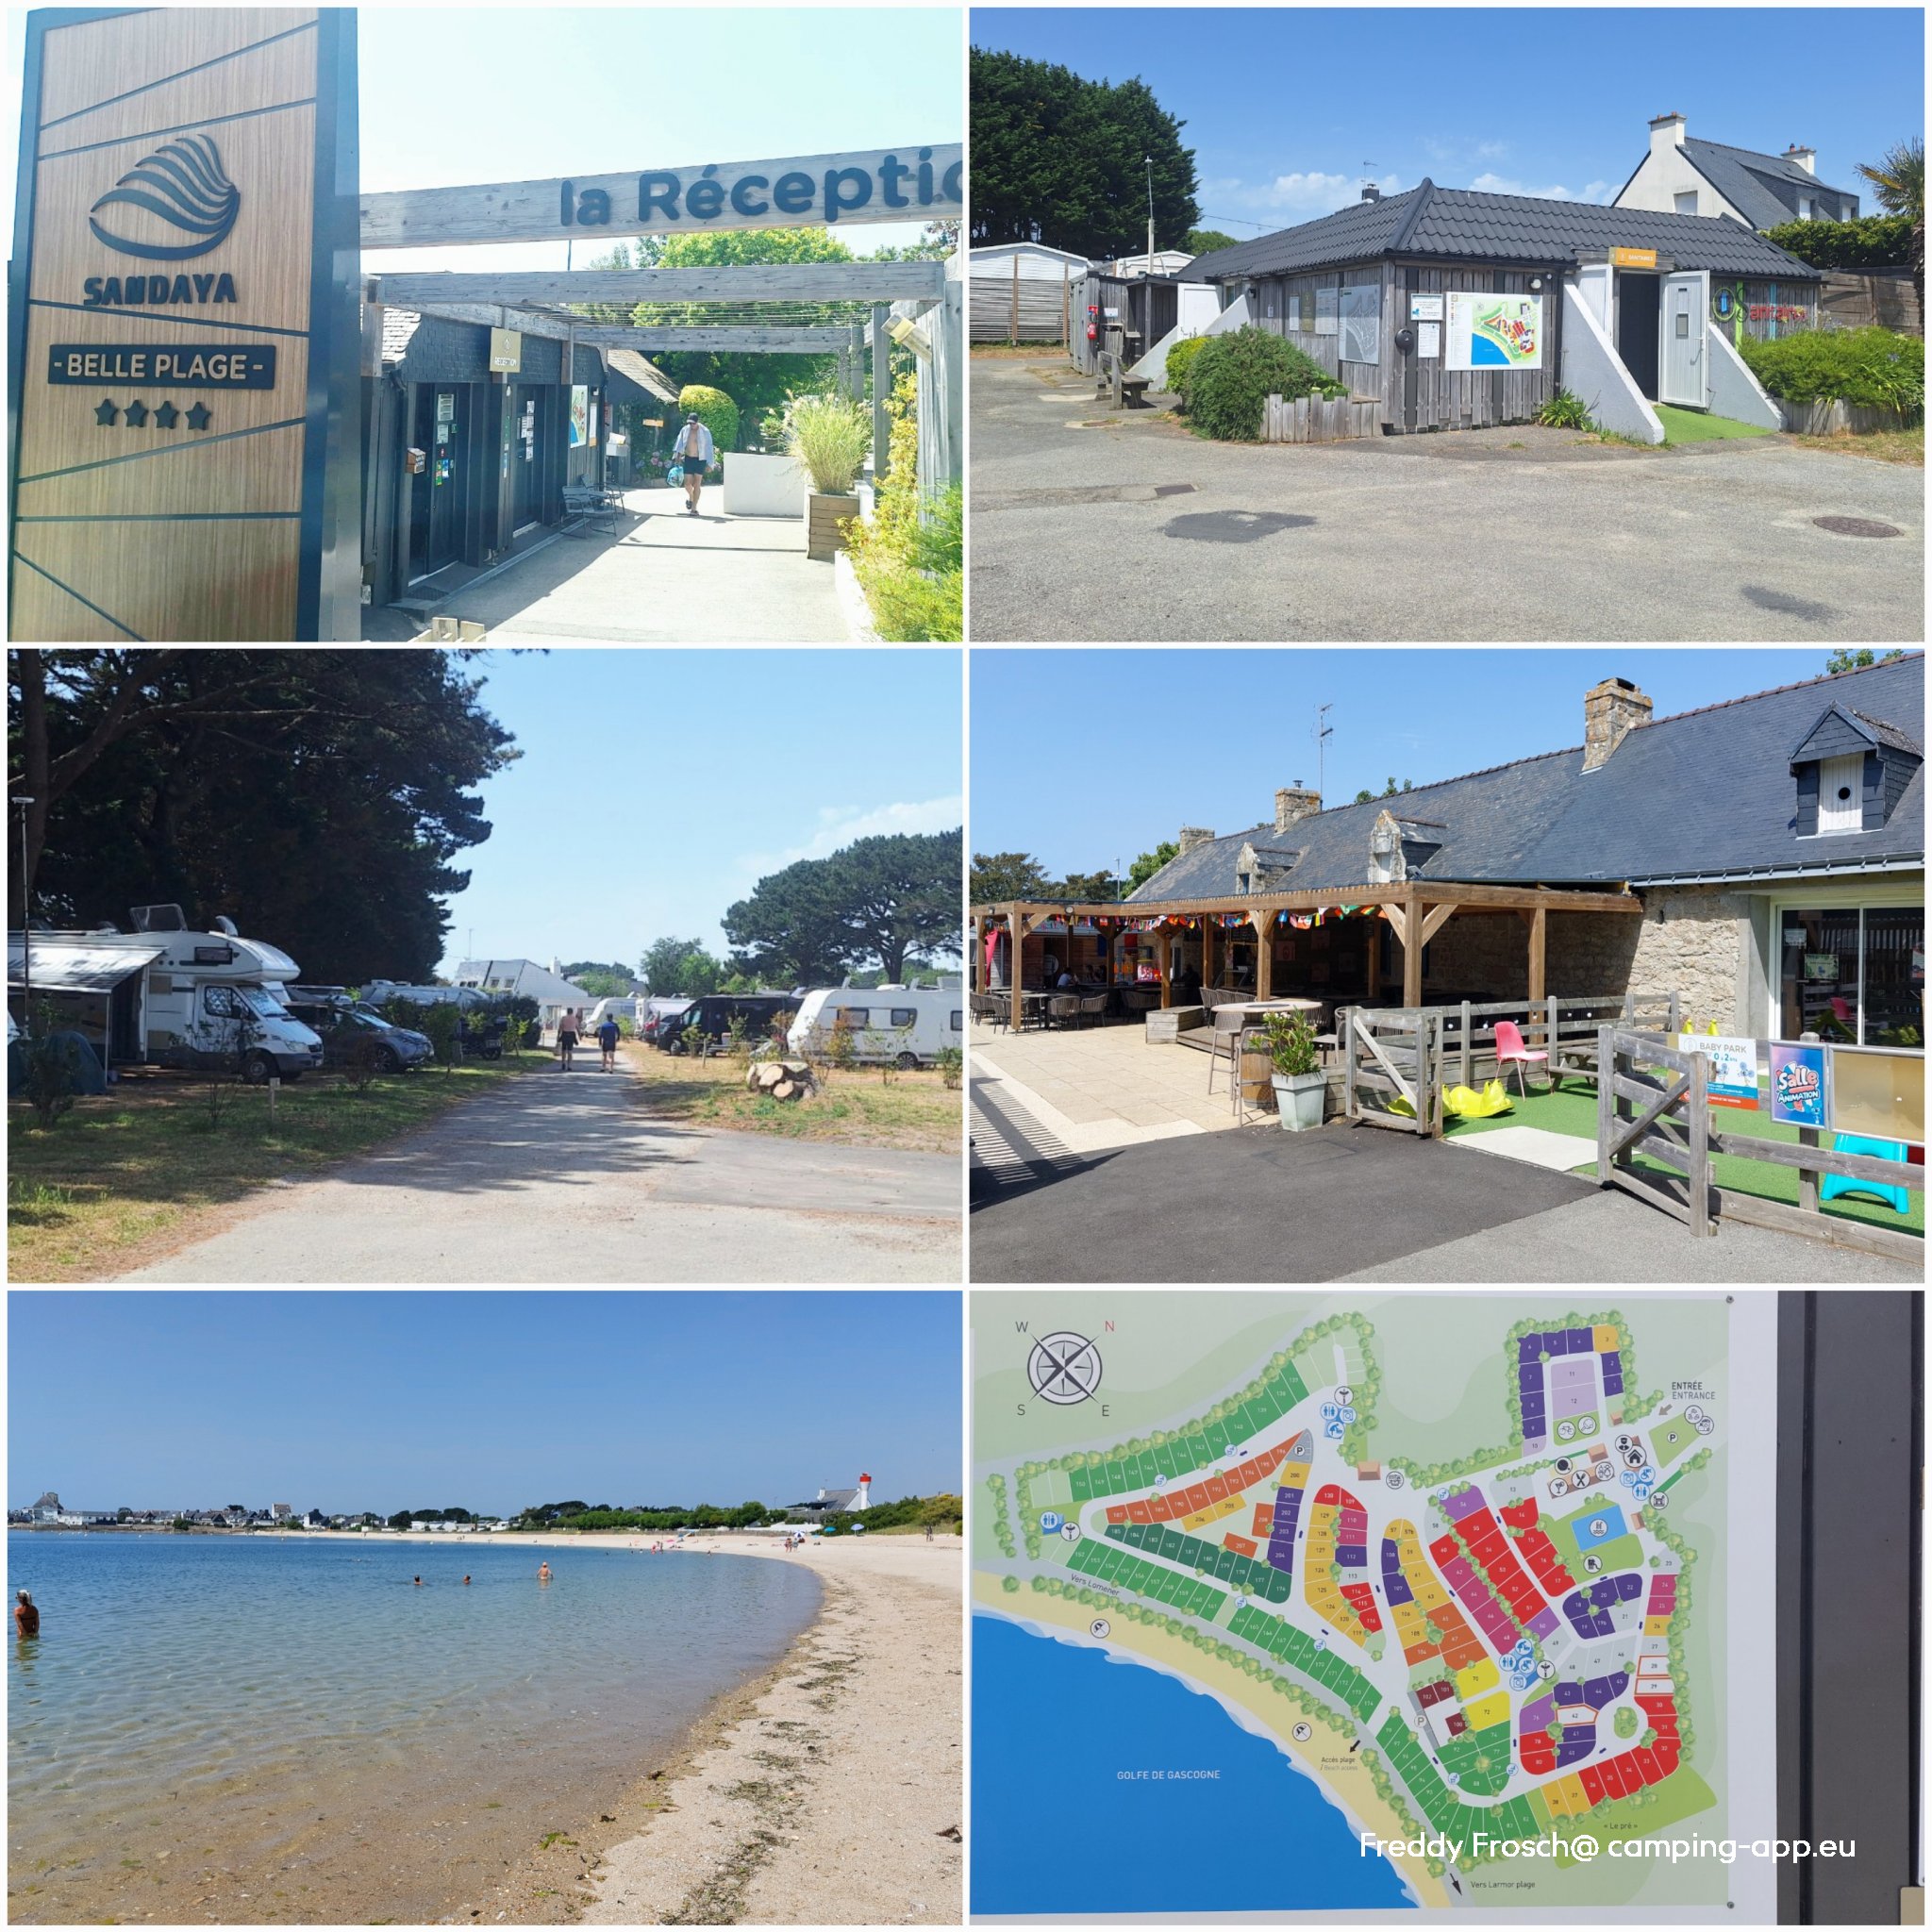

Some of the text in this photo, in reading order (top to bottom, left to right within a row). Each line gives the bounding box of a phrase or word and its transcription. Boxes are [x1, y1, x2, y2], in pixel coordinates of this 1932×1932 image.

[560, 179, 611, 226] la
[83, 273, 238, 306] SANDAYA
[1699, 1042, 1747, 1053] BABY PARK
[1714, 1052, 1719, 1060] 0
[1724, 1053, 1729, 1061] 2
[1778, 1068, 1818, 1090] Salle
[1777, 1091, 1819, 1103] ANIMATION
[1015, 1321, 1029, 1333] W
[1105, 1320, 1115, 1332] N
[1671, 1379, 1703, 1390] ENTRÉE
[1672, 1391, 1716, 1399] ENTRANCE
[1017, 1404, 1025, 1416] S
[1102, 1404, 1110, 1417] E
[1071, 1573, 1120, 1595] Vers Lomener
[1417, 1717, 1424, 1725] P
[1117, 1770, 1221, 1780] GOLFE DE GASCOGNE
[1516, 1881, 1535, 1890] plage
